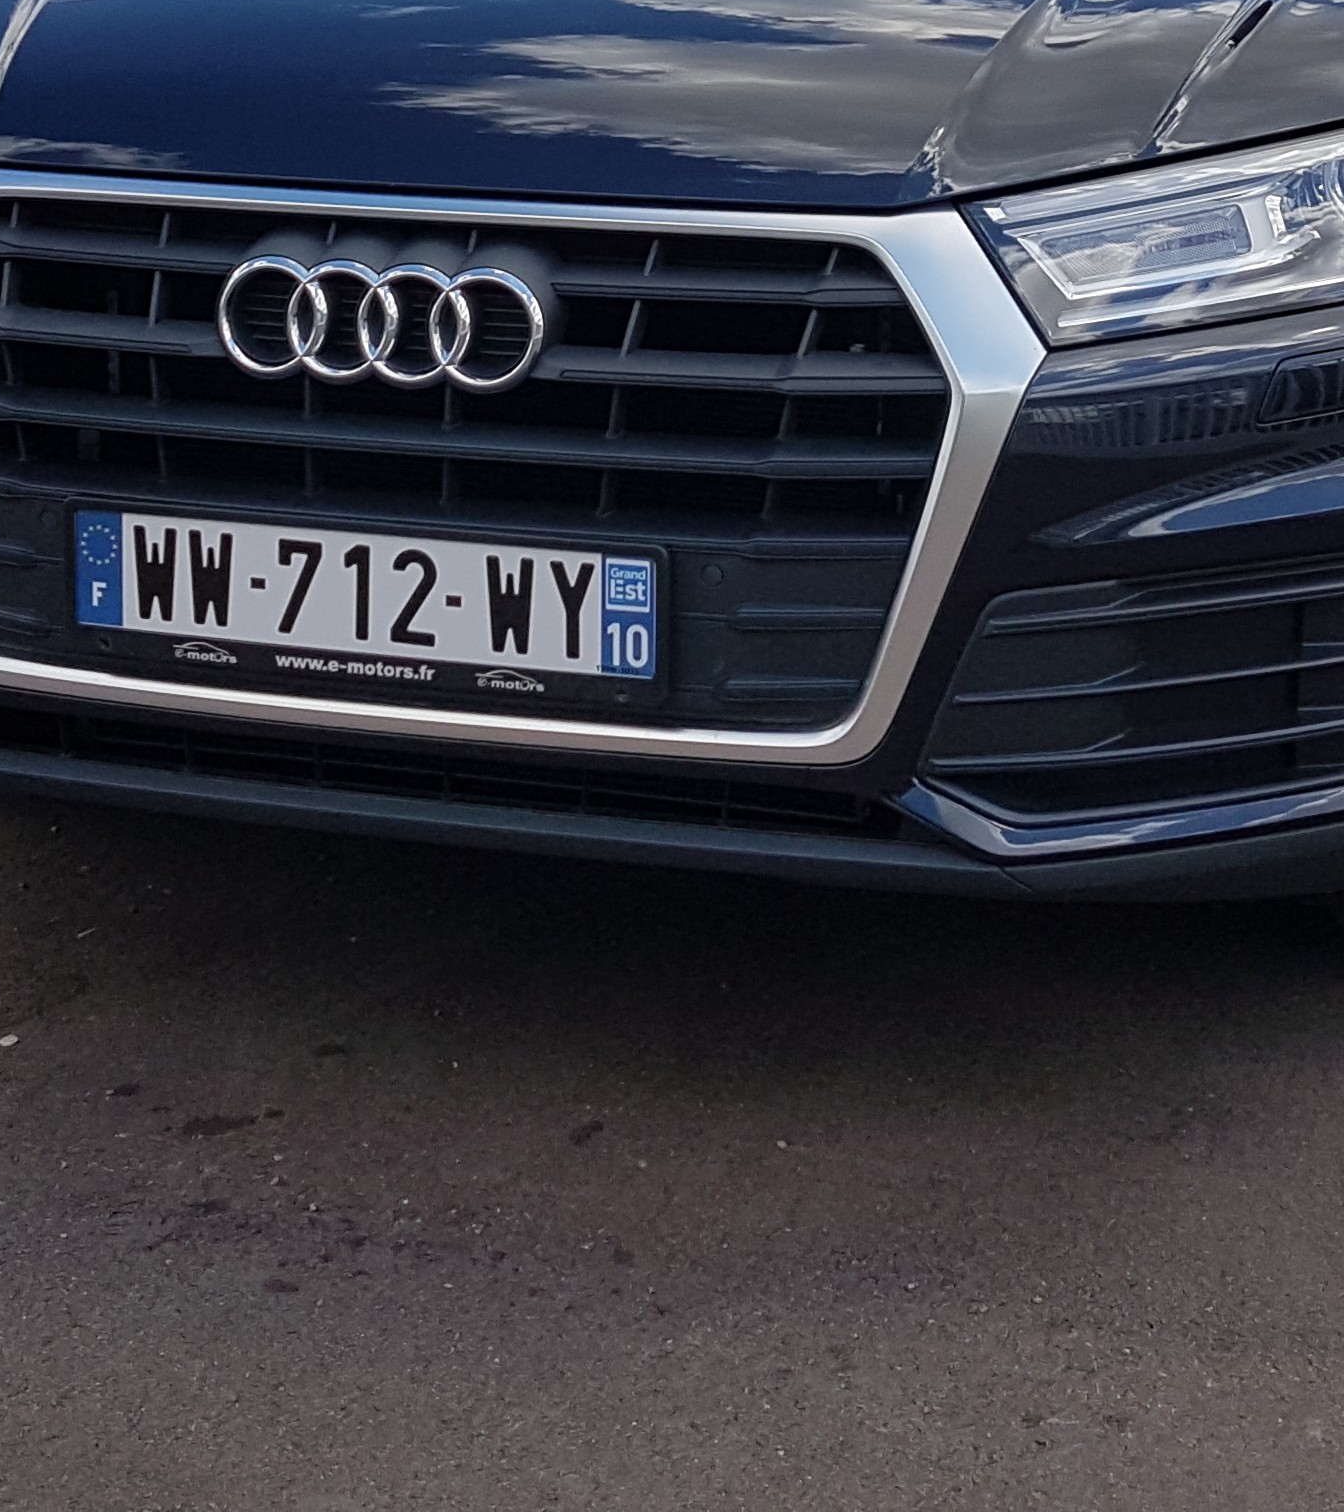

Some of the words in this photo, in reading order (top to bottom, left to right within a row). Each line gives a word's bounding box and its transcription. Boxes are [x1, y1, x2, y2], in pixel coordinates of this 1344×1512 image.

[610, 567, 646, 580] Grand
[92, 581, 107, 607] F
[133, 524, 596, 659] WW-712-WY
[610, 578, 646, 601] Est
[607, 622, 649, 668] 10
[275, 655, 436, 681] www.e-motors.fr
